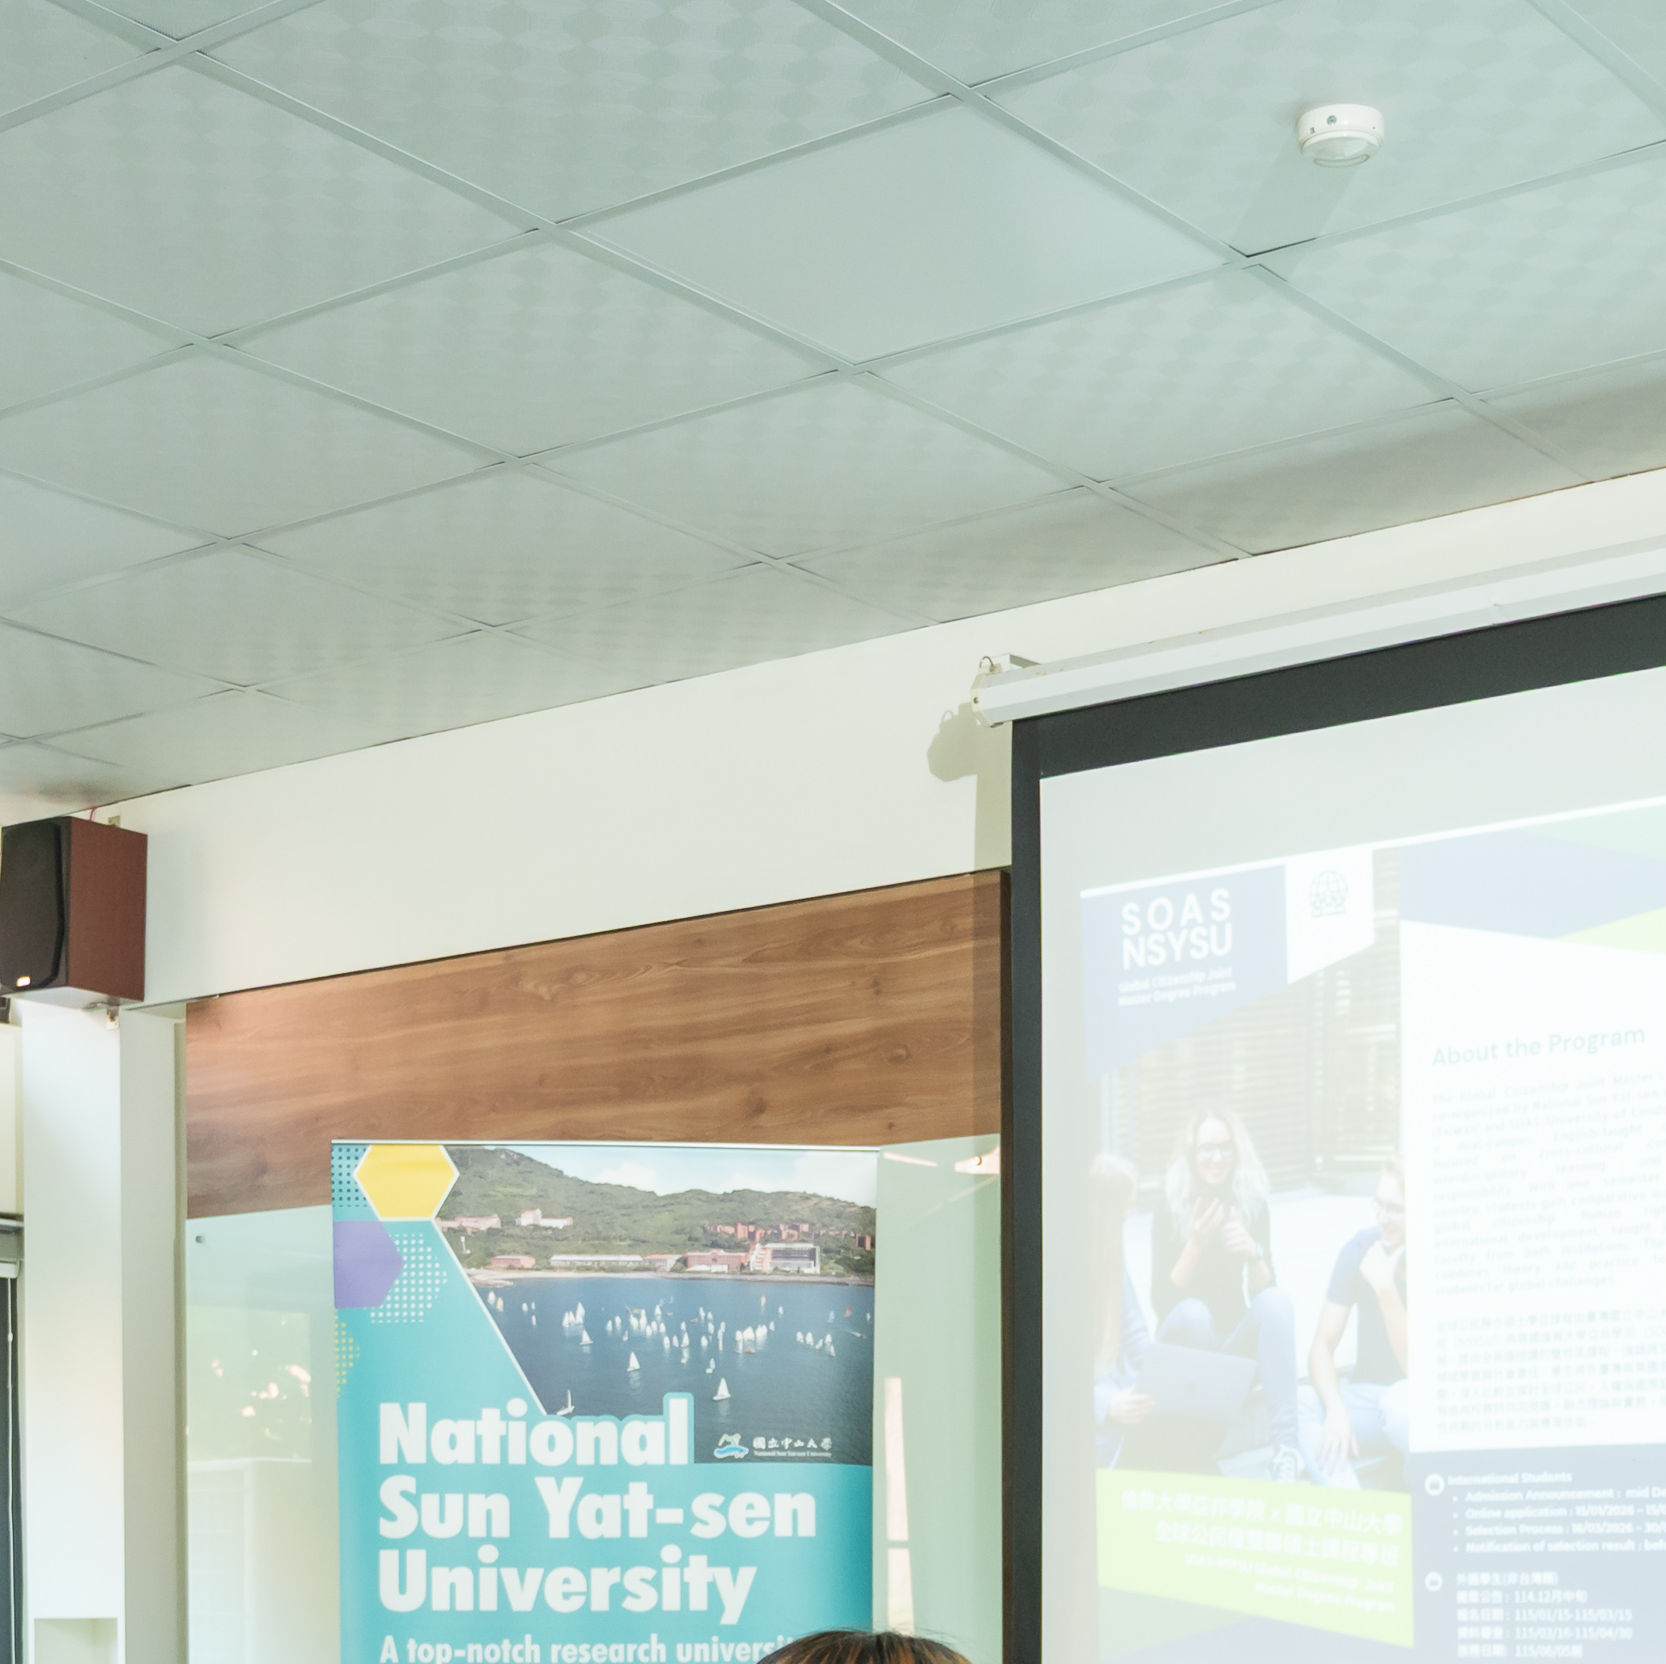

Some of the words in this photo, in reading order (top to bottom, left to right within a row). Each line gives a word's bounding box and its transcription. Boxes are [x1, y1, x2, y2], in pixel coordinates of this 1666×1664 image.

[1121, 888, 1232, 936] SOAS
[1121, 922, 1233, 971] NSYSU
[1432, 1043, 1498, 1067] About
[1505, 1038, 1542, 1059] the
[1548, 1028, 1646, 1055] Program
[379, 1398, 690, 1467] National
[752, 1436, 832, 1451] 國立中山大學
[1447, 1475, 1519, 1487] International
[1522, 1471, 1573, 1485] Students
[1465, 1490, 1523, 1502] Admission
[1525, 1488, 1614, 1500] Announcement
[1625, 1486, 1649, 1498] mid
[379, 1475, 511, 1540] Sun
[535, 1478, 816, 1540] Yat-sen
[1465, 1507, 1502, 1519] Online
[1503, 1506, 1568, 1520] application
[1575, 1503, 1635, 1516] 15/01/2026
[1465, 1523, 1517, 1536] Selection
[1519, 1523, 1564, 1536] Process
[1466, 1540, 1531, 1553] Notification
[1532, 1540, 1546, 1552] of
[1547, 1539, 1599, 1552] selection
[1601, 1539, 1635, 1551] result
[379, 1543, 757, 1625] University
[380, 1635, 399, 1664] A
[550, 1634, 667, 1664] research
